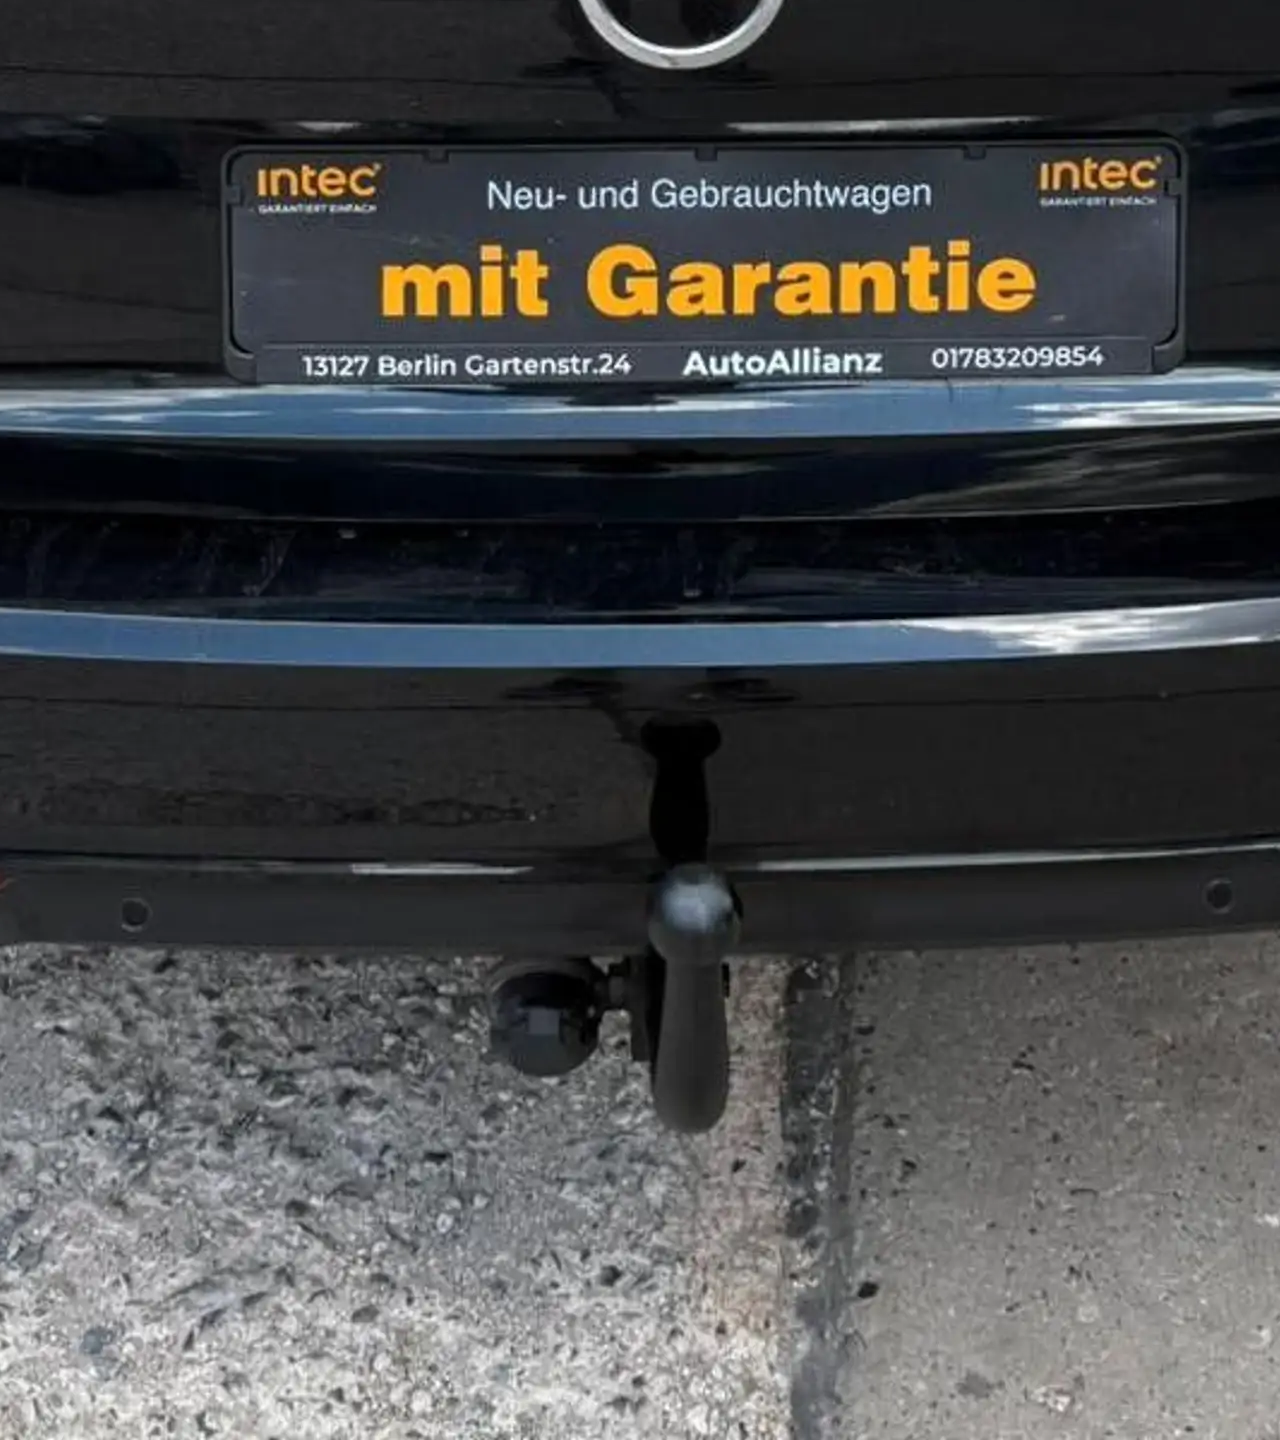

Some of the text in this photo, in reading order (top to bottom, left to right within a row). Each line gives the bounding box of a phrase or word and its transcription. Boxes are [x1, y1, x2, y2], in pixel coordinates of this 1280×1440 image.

[486, 176, 933, 215] Neu- und Gebrauchtwagen
[382, 240, 1037, 318] mit Garantie
[301, 351, 633, 378] 13127 Berlin Gartenstr.24
[681, 346, 884, 378] AutoAllianz
[930, 345, 1106, 370] 01783209854
